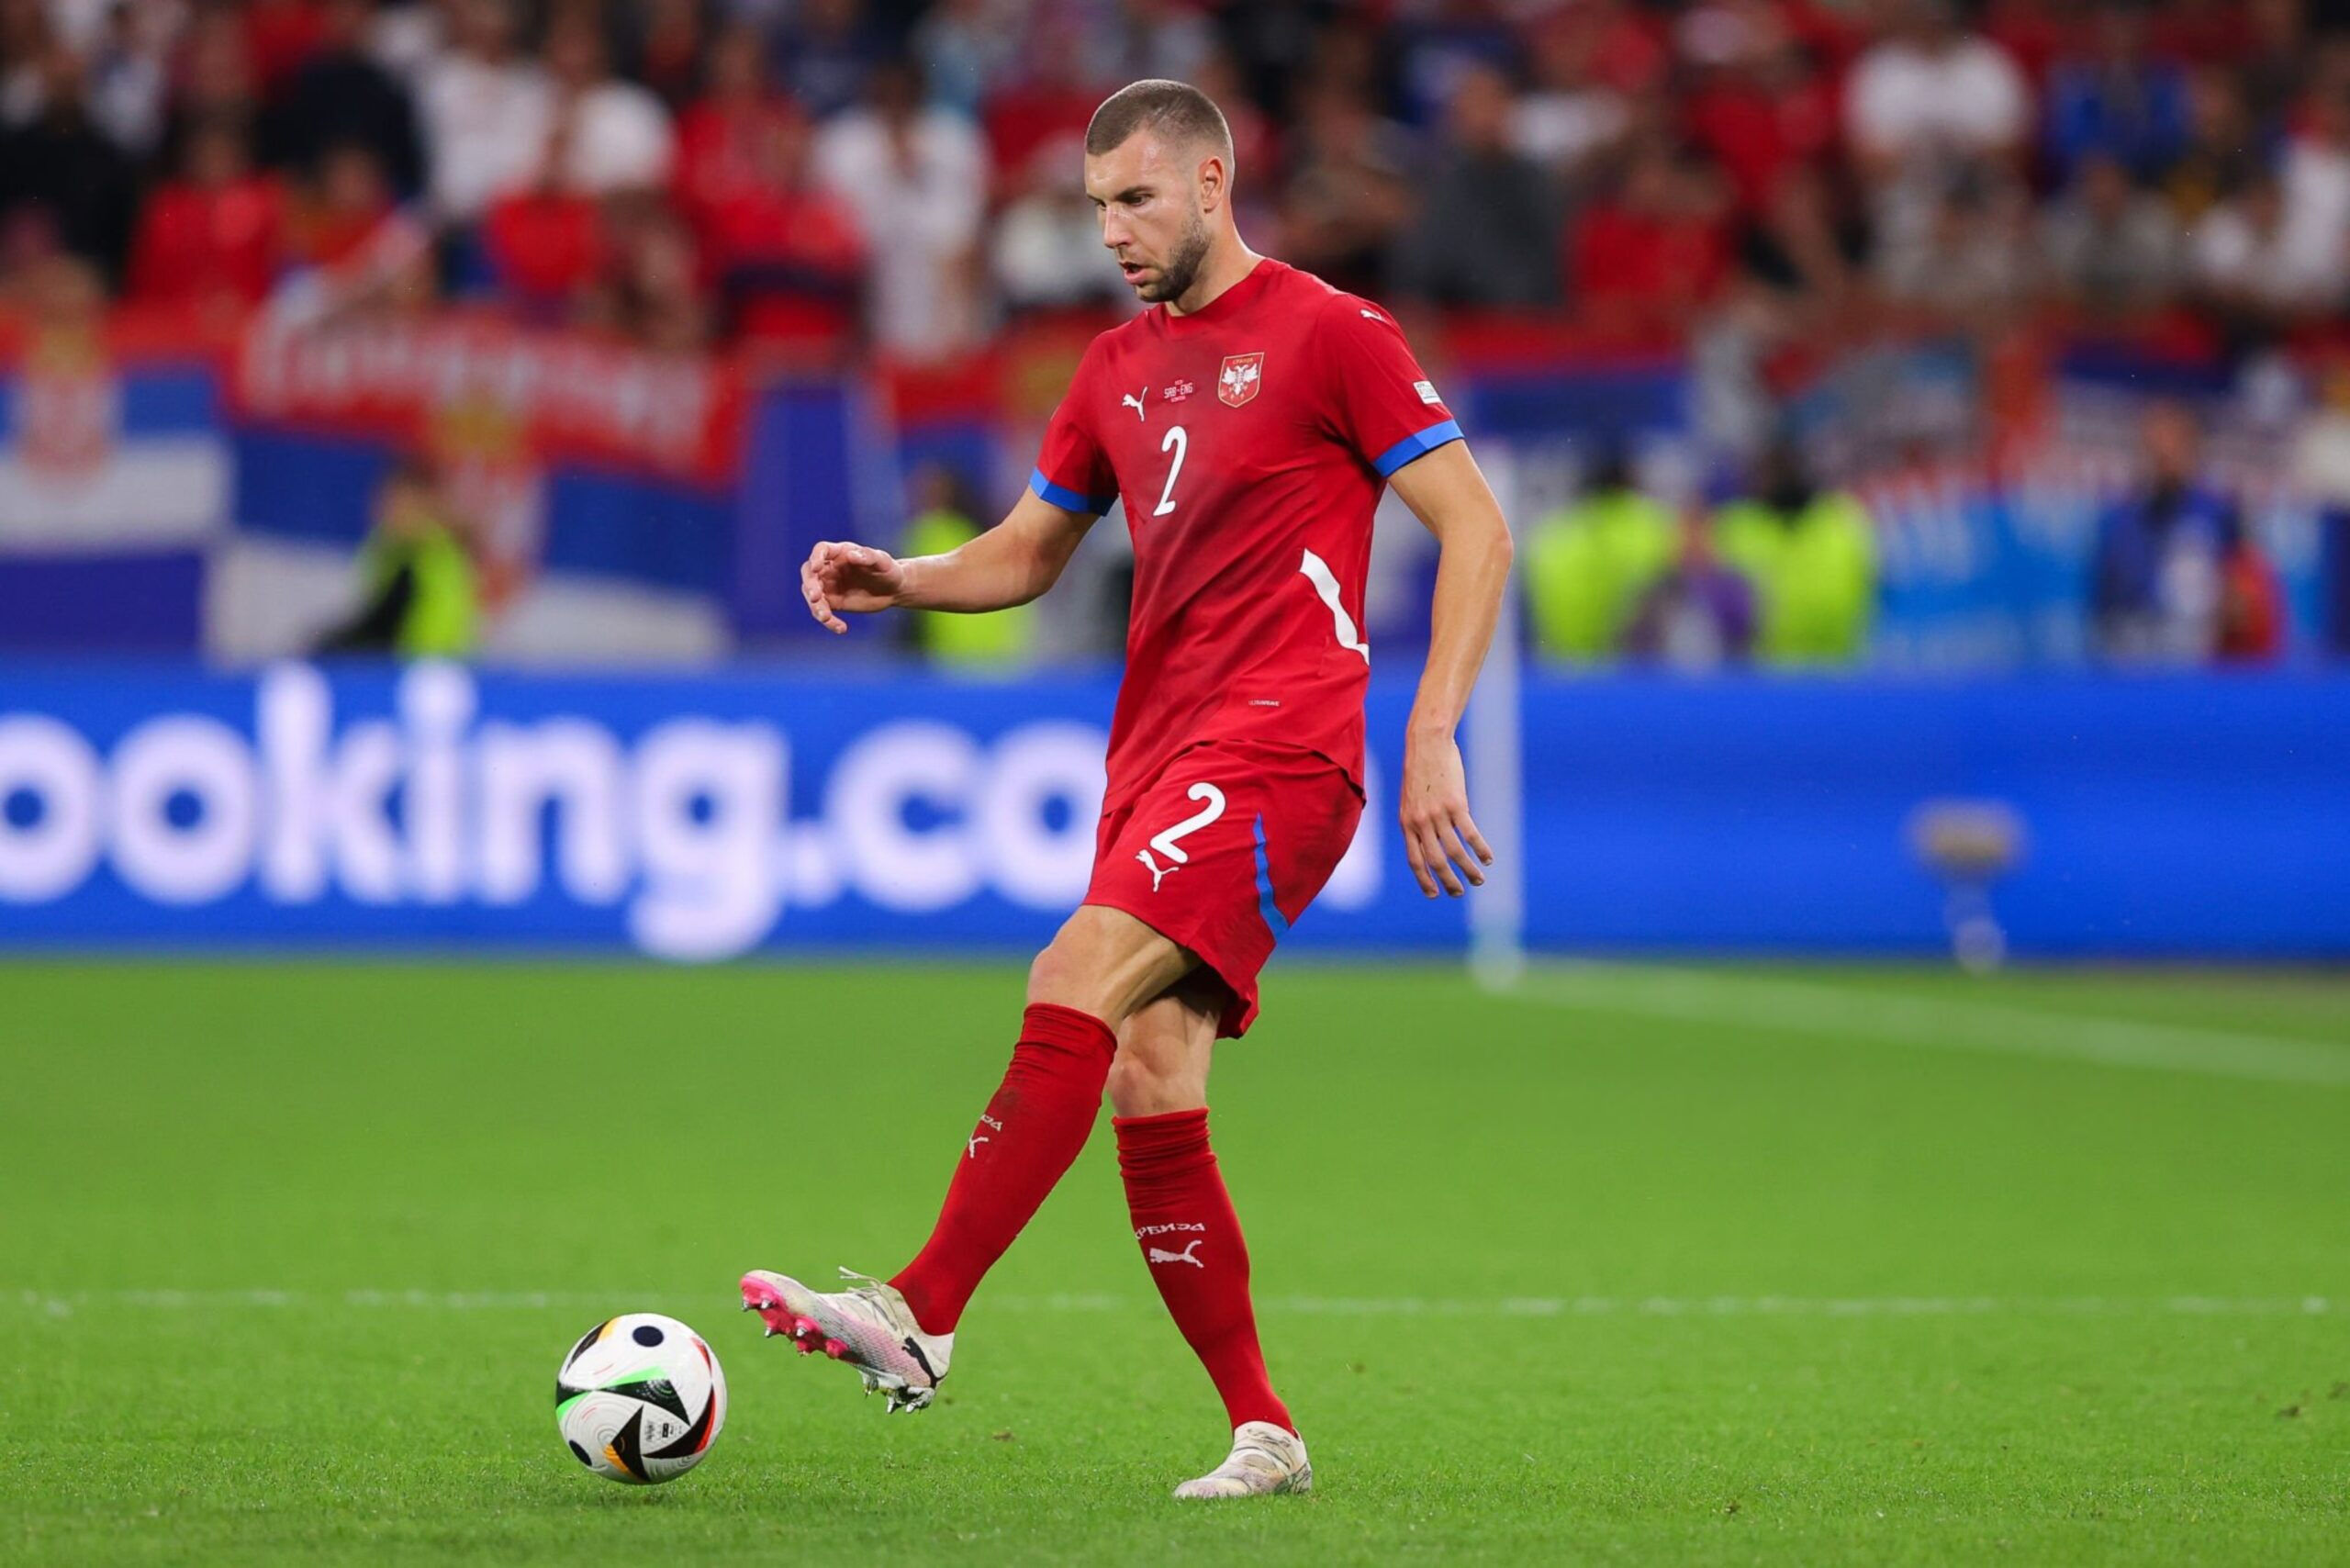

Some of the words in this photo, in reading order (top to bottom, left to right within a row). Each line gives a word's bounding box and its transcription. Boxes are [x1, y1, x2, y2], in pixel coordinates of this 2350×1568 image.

[1152, 425, 1189, 517] 2
[0, 659, 1381, 962] ooking.co
[1149, 781, 1226, 865] 2
